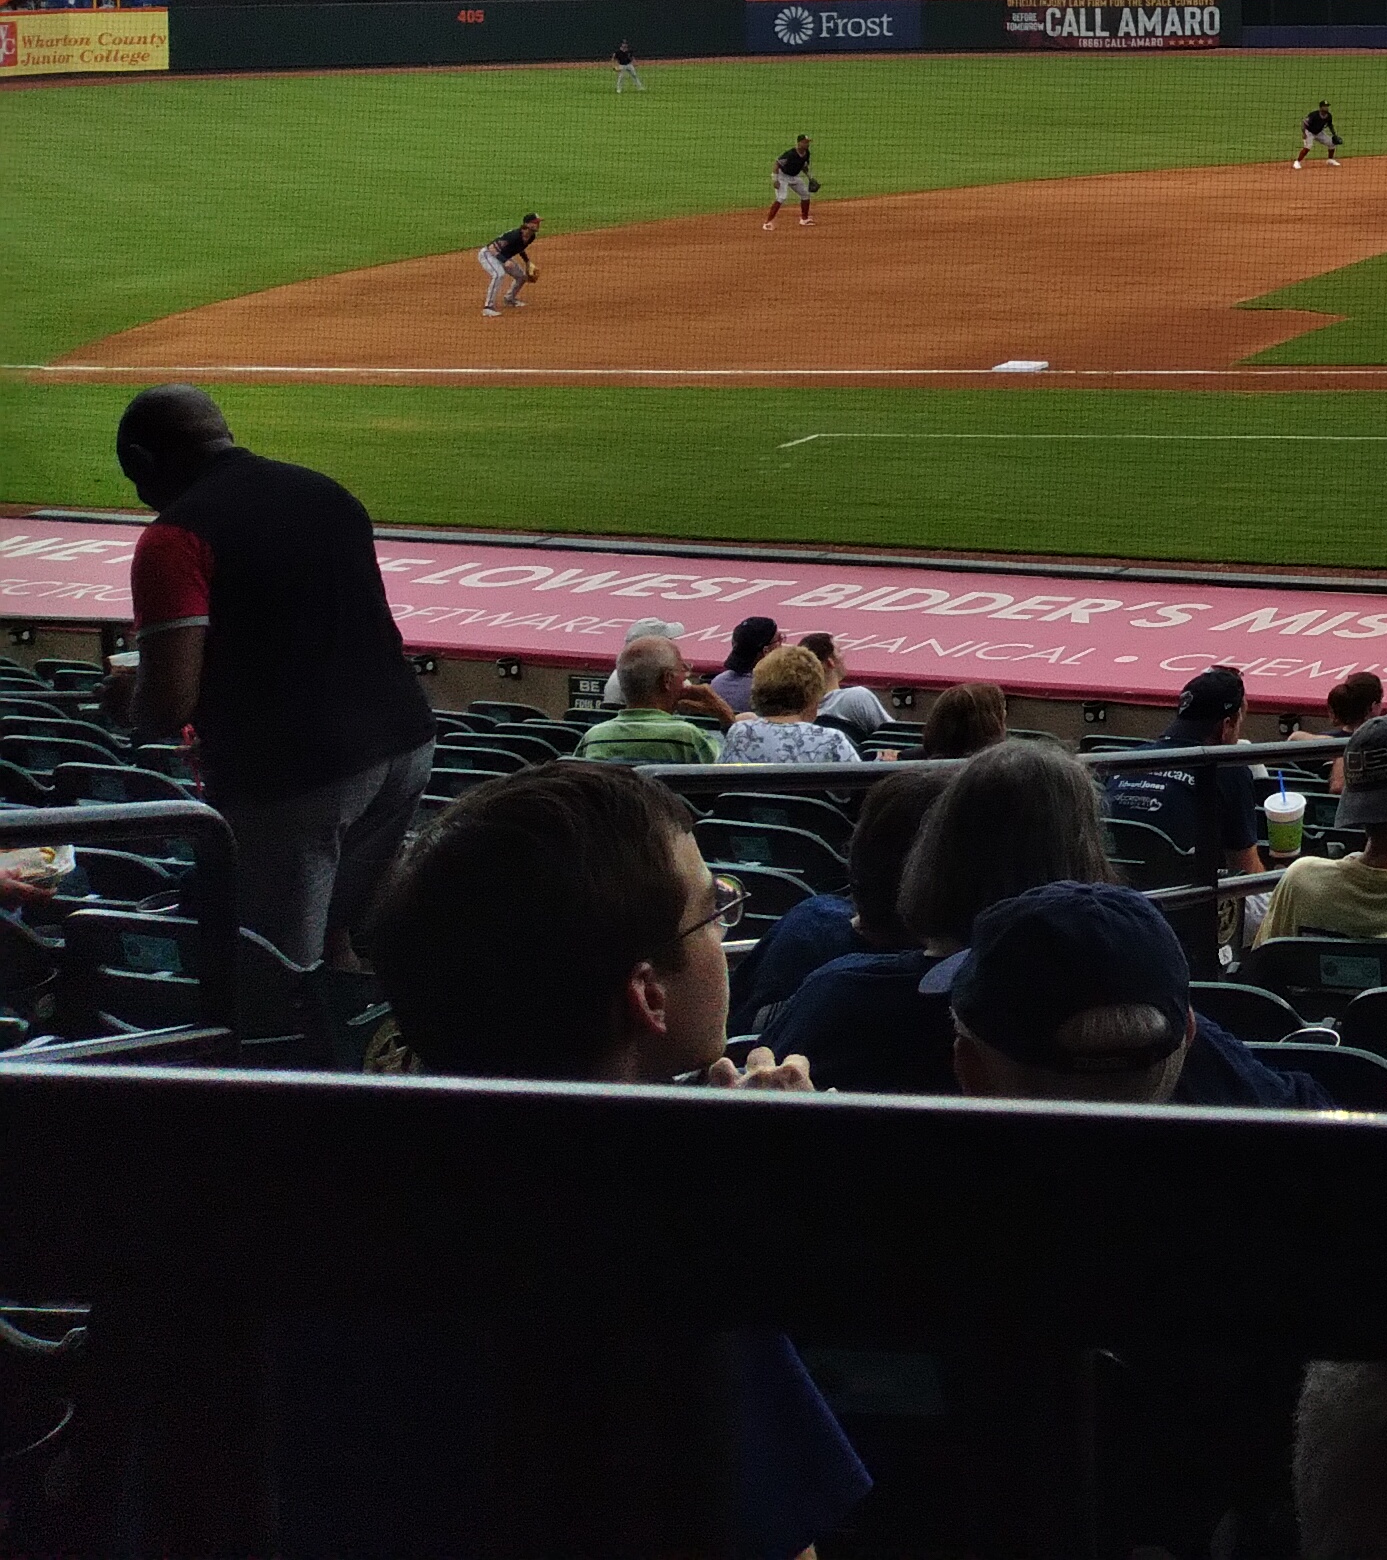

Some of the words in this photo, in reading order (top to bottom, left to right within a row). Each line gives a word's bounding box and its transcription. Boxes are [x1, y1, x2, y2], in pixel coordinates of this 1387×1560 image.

[457, 10, 485, 22] 405
[1012, 12, 1037, 22] BEFORE
[1046, 8, 1110, 37] CALL
[1118, 6, 1220, 36] AMARO
[820, 12, 893, 38] Frost
[1006, 22, 1044, 31] TOMORROW
[22, 35, 90, 49] Wharton
[98, 32, 167, 48] County
[1079, 38, 1102, 48] (866)
[1105, 38, 1163, 48] CALL-AMARO
[20, 51, 74, 66] Junior
[80, 49, 150, 66] College
[411, 562, 798, 603] LOWEST
[780, 583, 1213, 628] BIDDER'S
